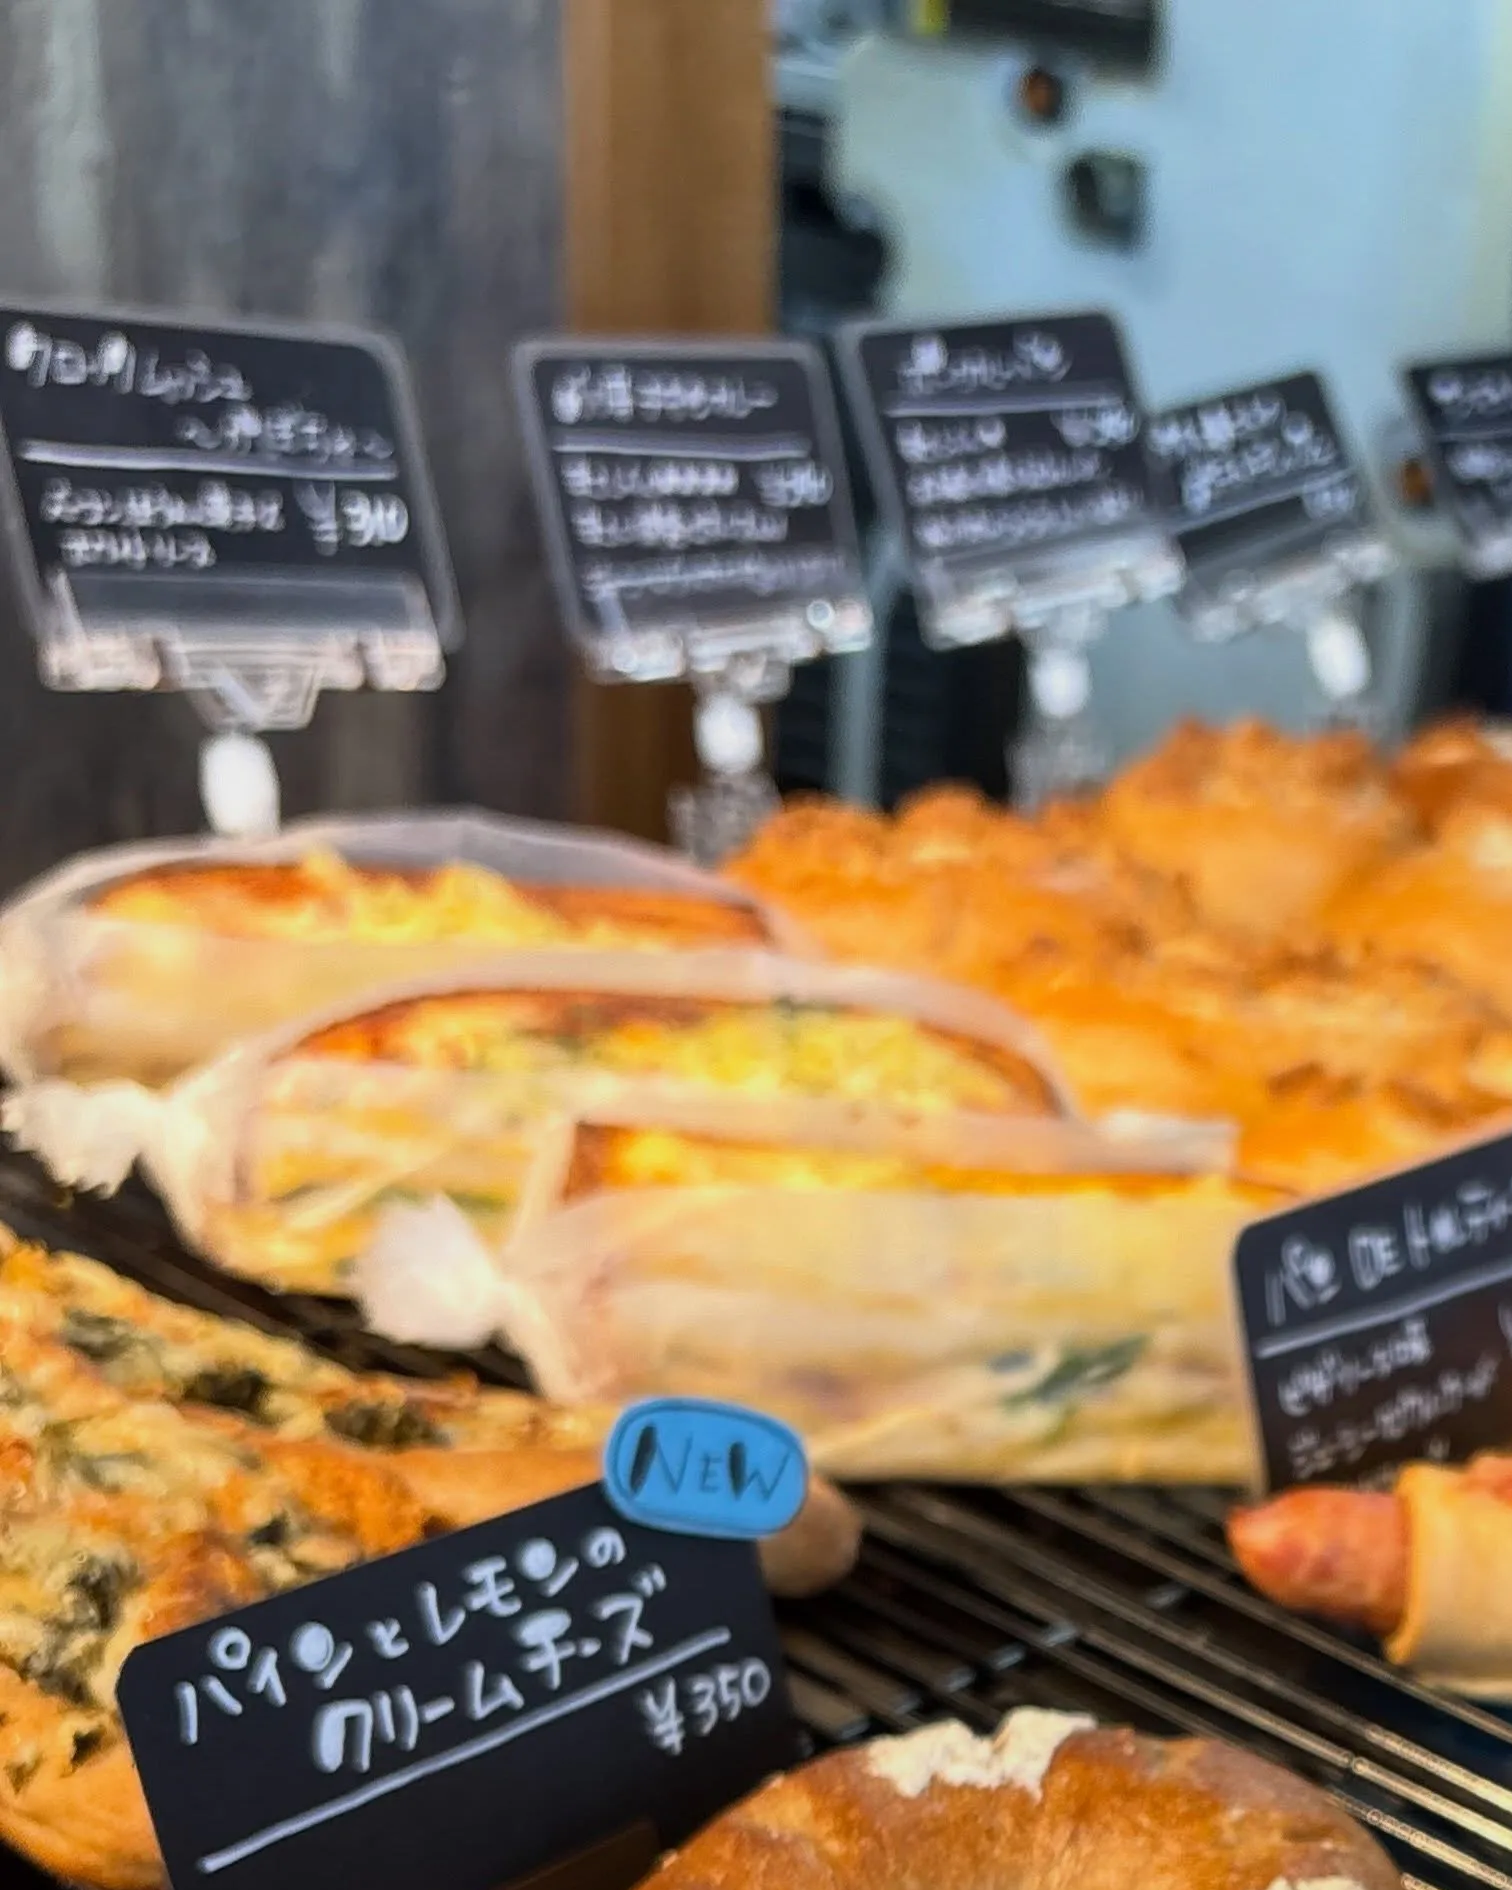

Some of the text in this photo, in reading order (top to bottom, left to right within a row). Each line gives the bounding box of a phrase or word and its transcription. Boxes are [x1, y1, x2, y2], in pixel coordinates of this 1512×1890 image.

[628, 1423, 790, 1502] NEW
[174, 1526, 626, 1746] パインとレモンの
[312, 1564, 667, 1773] クリームチーズ
[637, 1656, 771, 1756] ¥350
